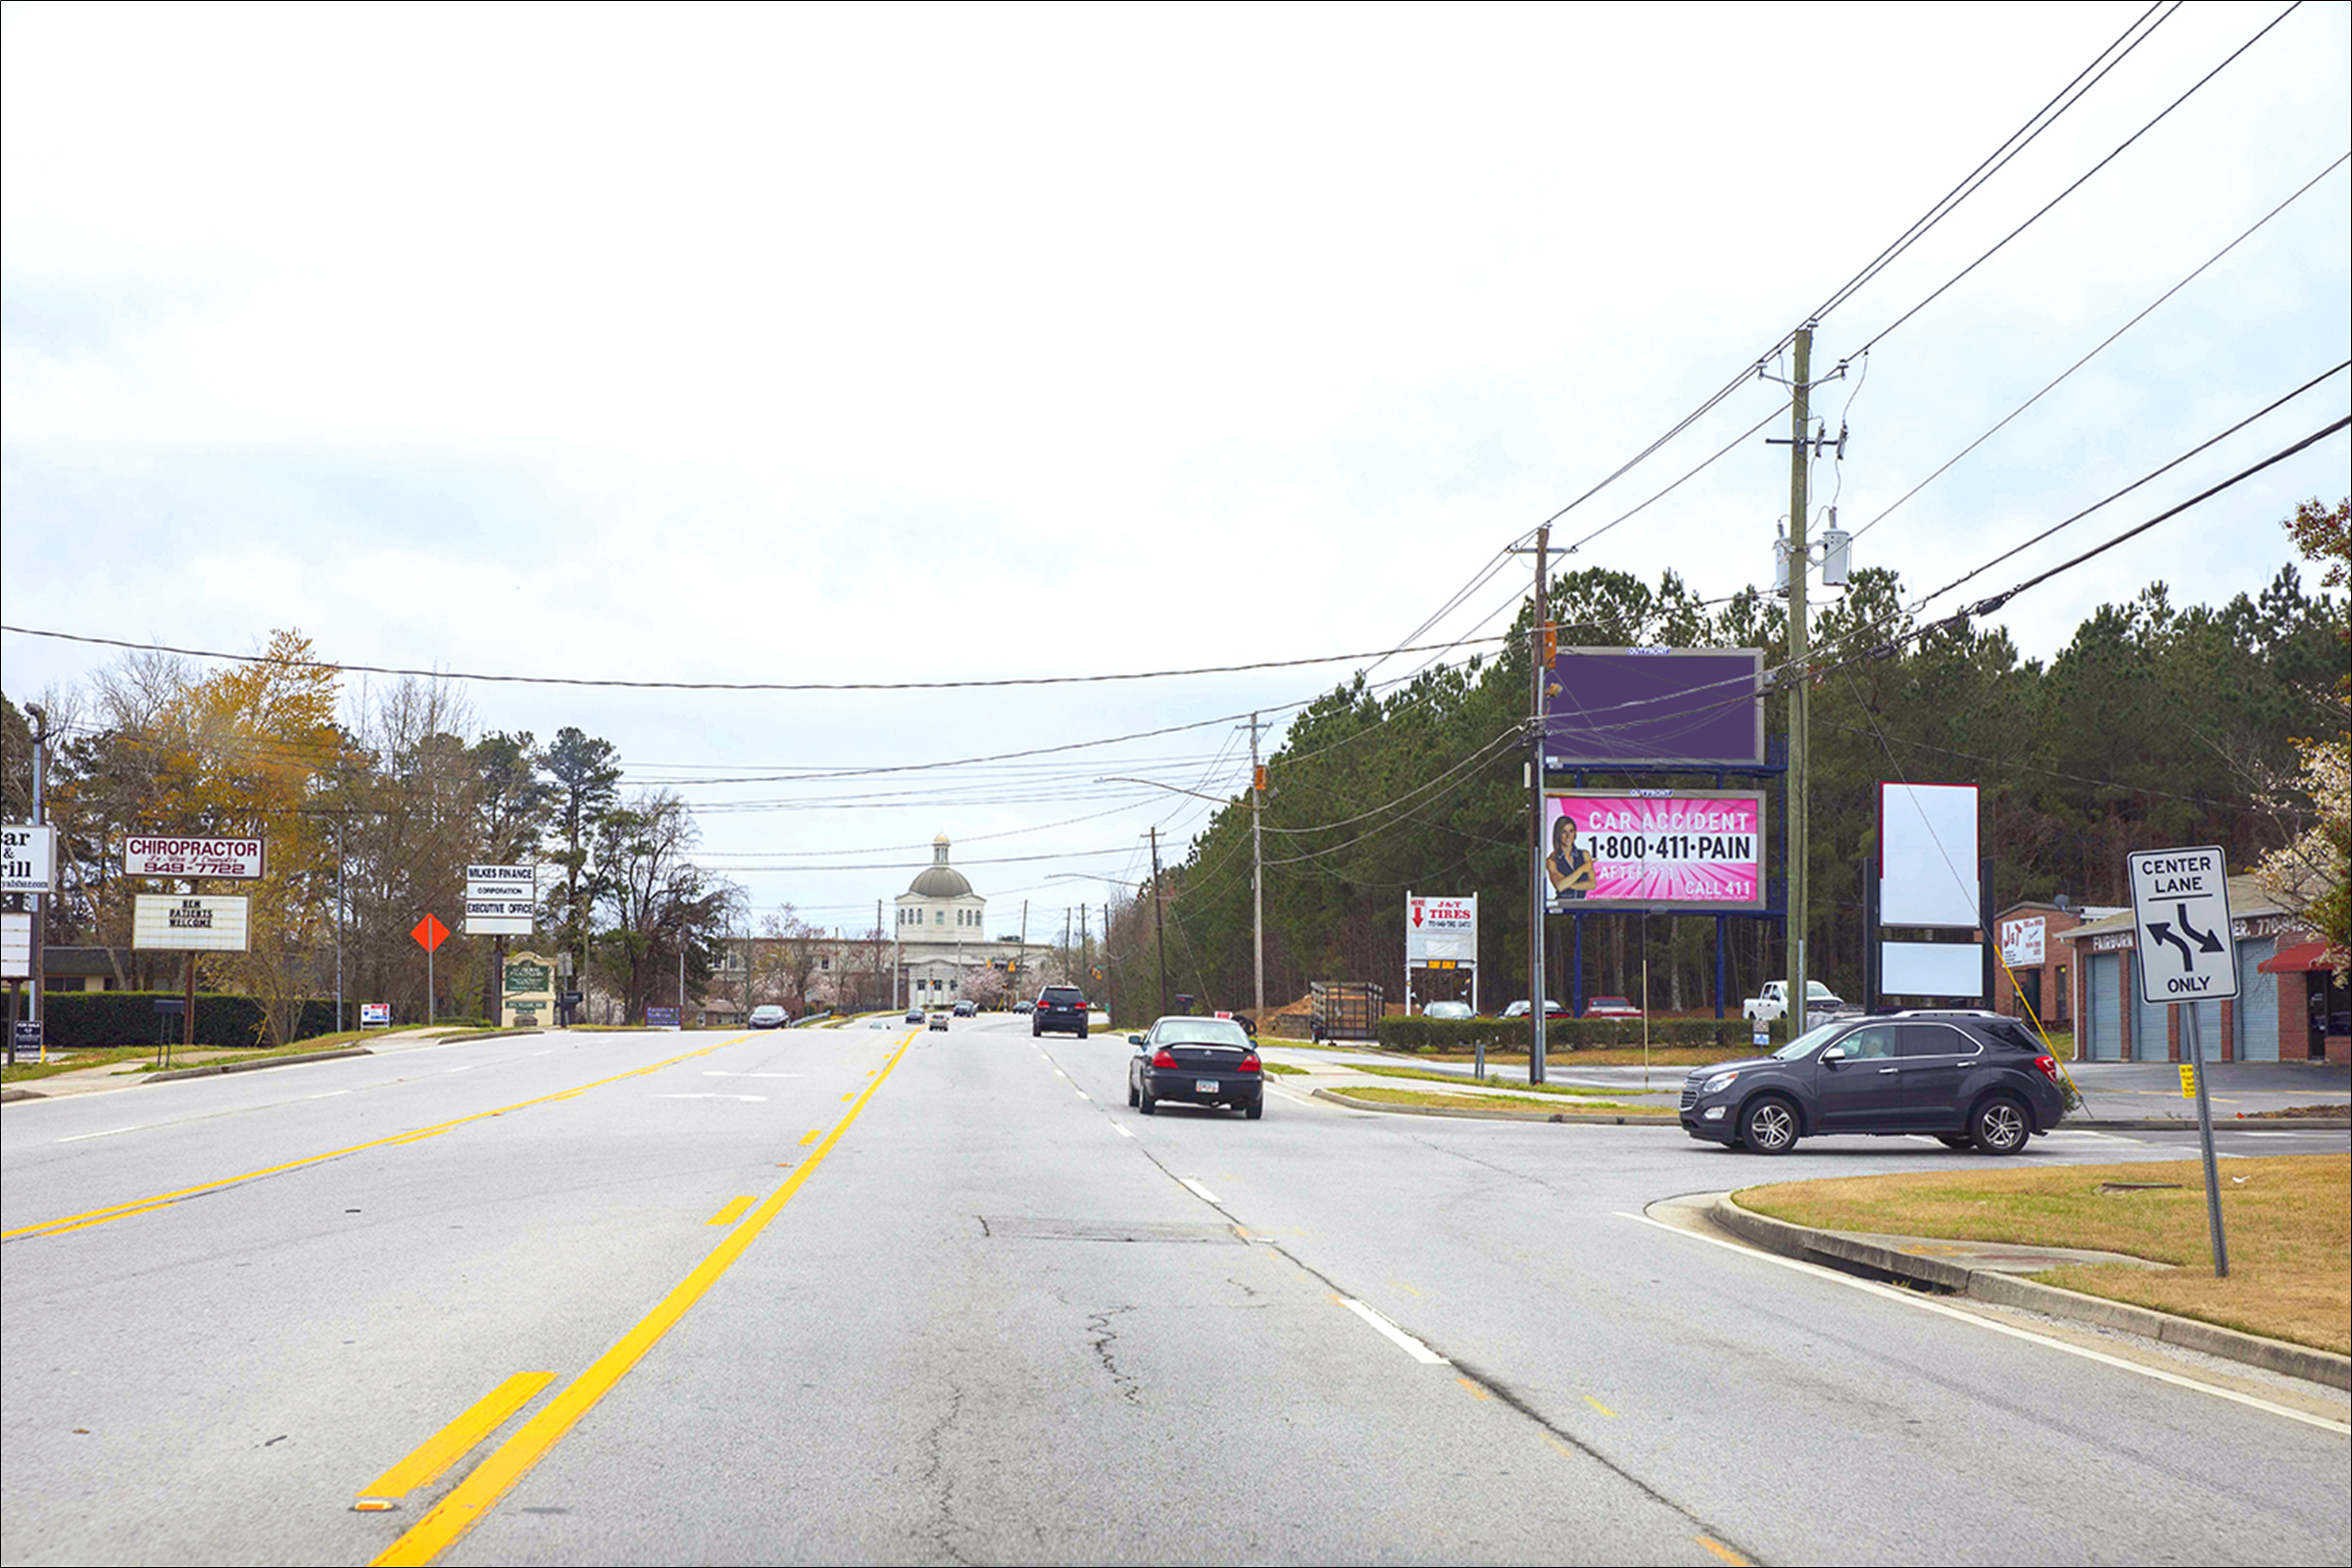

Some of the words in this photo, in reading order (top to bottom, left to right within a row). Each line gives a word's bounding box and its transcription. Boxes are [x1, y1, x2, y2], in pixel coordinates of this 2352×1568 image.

[1589, 811, 1632, 830] CAR
[1642, 812, 1749, 831] ACCIDENT
[1, 830, 31, 847] ar
[129, 840, 258, 857] CHIROPRACTOR
[144, 862, 245, 874] 949-7722
[468, 868, 497, 879] WILKES
[499, 868, 532, 879] FINANCE
[1599, 866, 1643, 880] AFTER
[2141, 857, 2211, 875] CENTER
[1686, 881, 1722, 896] CALL
[1725, 882, 1750, 896] 411
[2155, 877, 2203, 893] LANE
[169, 908, 214, 918] PATIENTS
[467, 903, 505, 913] EXECUTIVE
[508, 904, 533, 913] OFFICE
[1429, 908, 1472, 919] TIRES
[169, 918, 213, 928] WELCOME
[2091, 932, 2134, 952] FAIRBURN
[2167, 976, 2211, 994] ONLY
